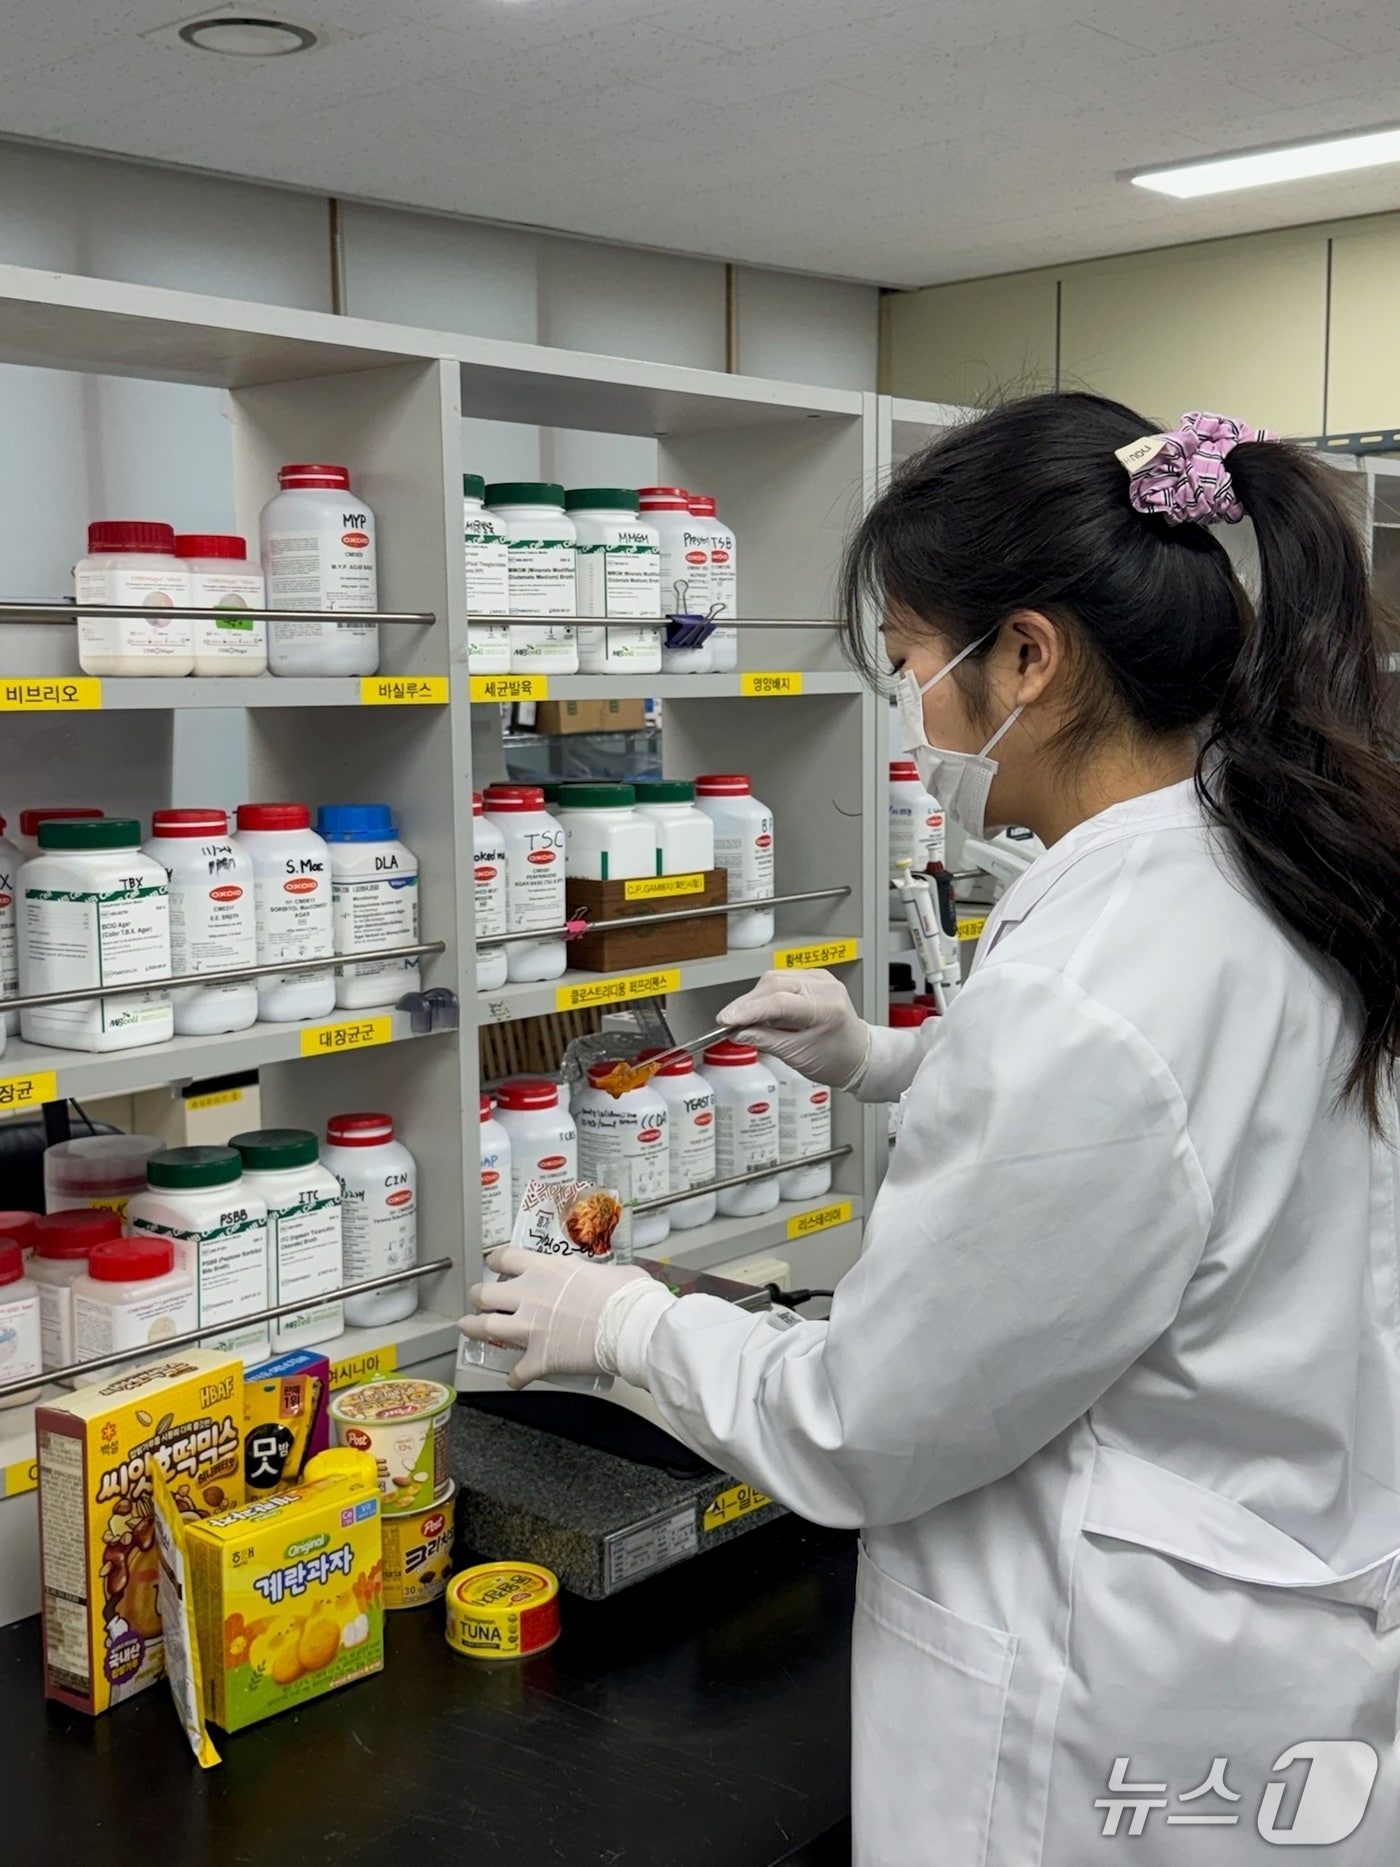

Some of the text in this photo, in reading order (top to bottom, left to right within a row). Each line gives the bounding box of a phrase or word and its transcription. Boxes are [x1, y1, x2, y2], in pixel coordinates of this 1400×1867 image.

[343, 513, 367, 529] MYP
[378, 682, 432, 700] 바실루스
[484, 680, 532, 696] 세균발육
[753, 677, 790, 692] 영양배지
[6, 684, 79, 703] 비브리오
[524, 830, 563, 850] TSC
[375, 855, 399, 870] DLA
[119, 877, 143, 889] TBX
[285, 880, 317, 892] OXOID
[211, 888, 242, 899] OXOID
[785, 945, 847, 967] 황색포도상구균
[570, 982, 626, 1004] 클로스트리디움
[319, 1024, 375, 1048] 대장균군
[384, 1173, 408, 1188] CIN
[298, 1190, 319, 1204] ITC
[220, 1209, 248, 1226] PSBB
[798, 1208, 841, 1231] 리스테리아
[200, 1376, 235, 1409] HBAF
[285, 1395, 301, 1409] 1위
[347, 1431, 369, 1447] Post
[100, 1441, 119, 1456] 백설
[423, 1516, 443, 1535] Post
[288, 1536, 325, 1558] Original
[254, 1545, 353, 1602] 계란과자
[460, 1621, 502, 1641] TUNA
[109, 1643, 141, 1668] 국내산
